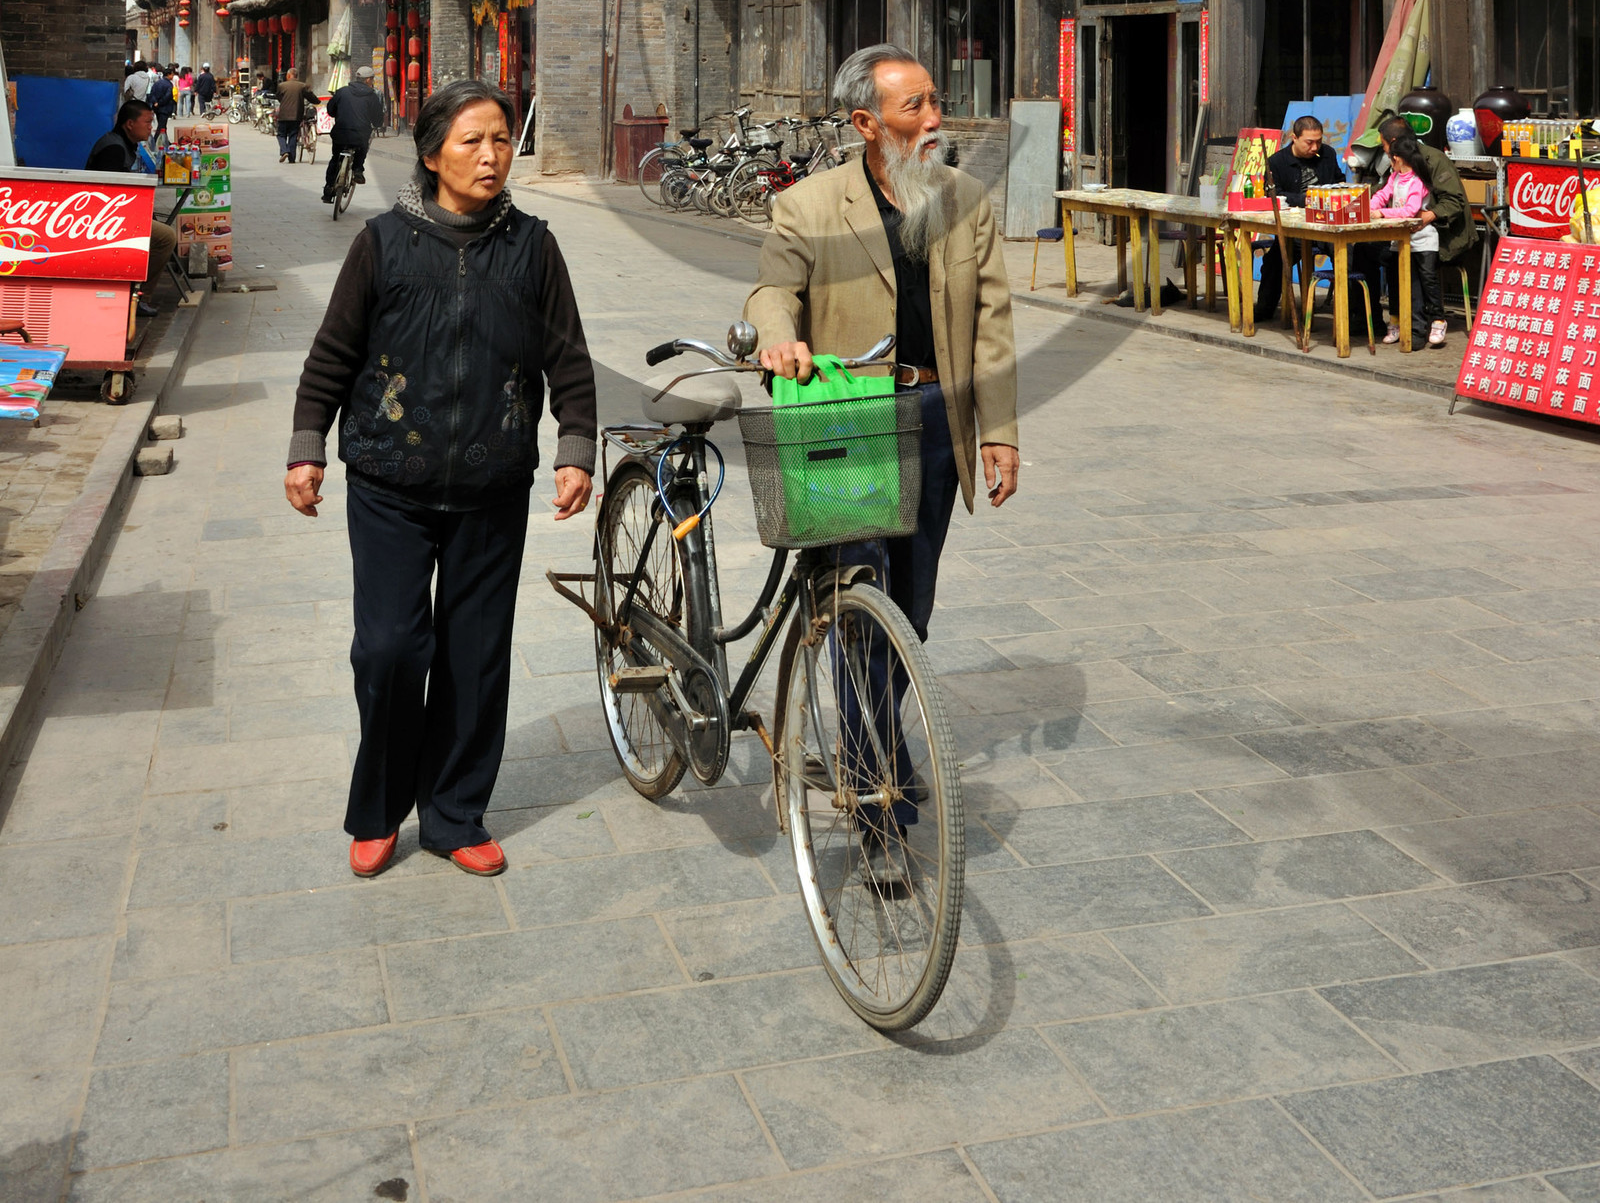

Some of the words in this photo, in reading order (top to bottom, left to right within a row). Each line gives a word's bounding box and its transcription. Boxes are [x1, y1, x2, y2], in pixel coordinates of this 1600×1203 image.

[1492, 268, 1567, 293] 蛋炒绿豆饼
[1480, 310, 1555, 337] 西红柿莜面鱼
[1468, 351, 1547, 381] 羊汤切圪塔
[1560, 344, 1598, 367] 剪刀
[1462, 373, 1540, 403] 牛肉刀削面
[1555, 367, 1594, 391] 莜面
